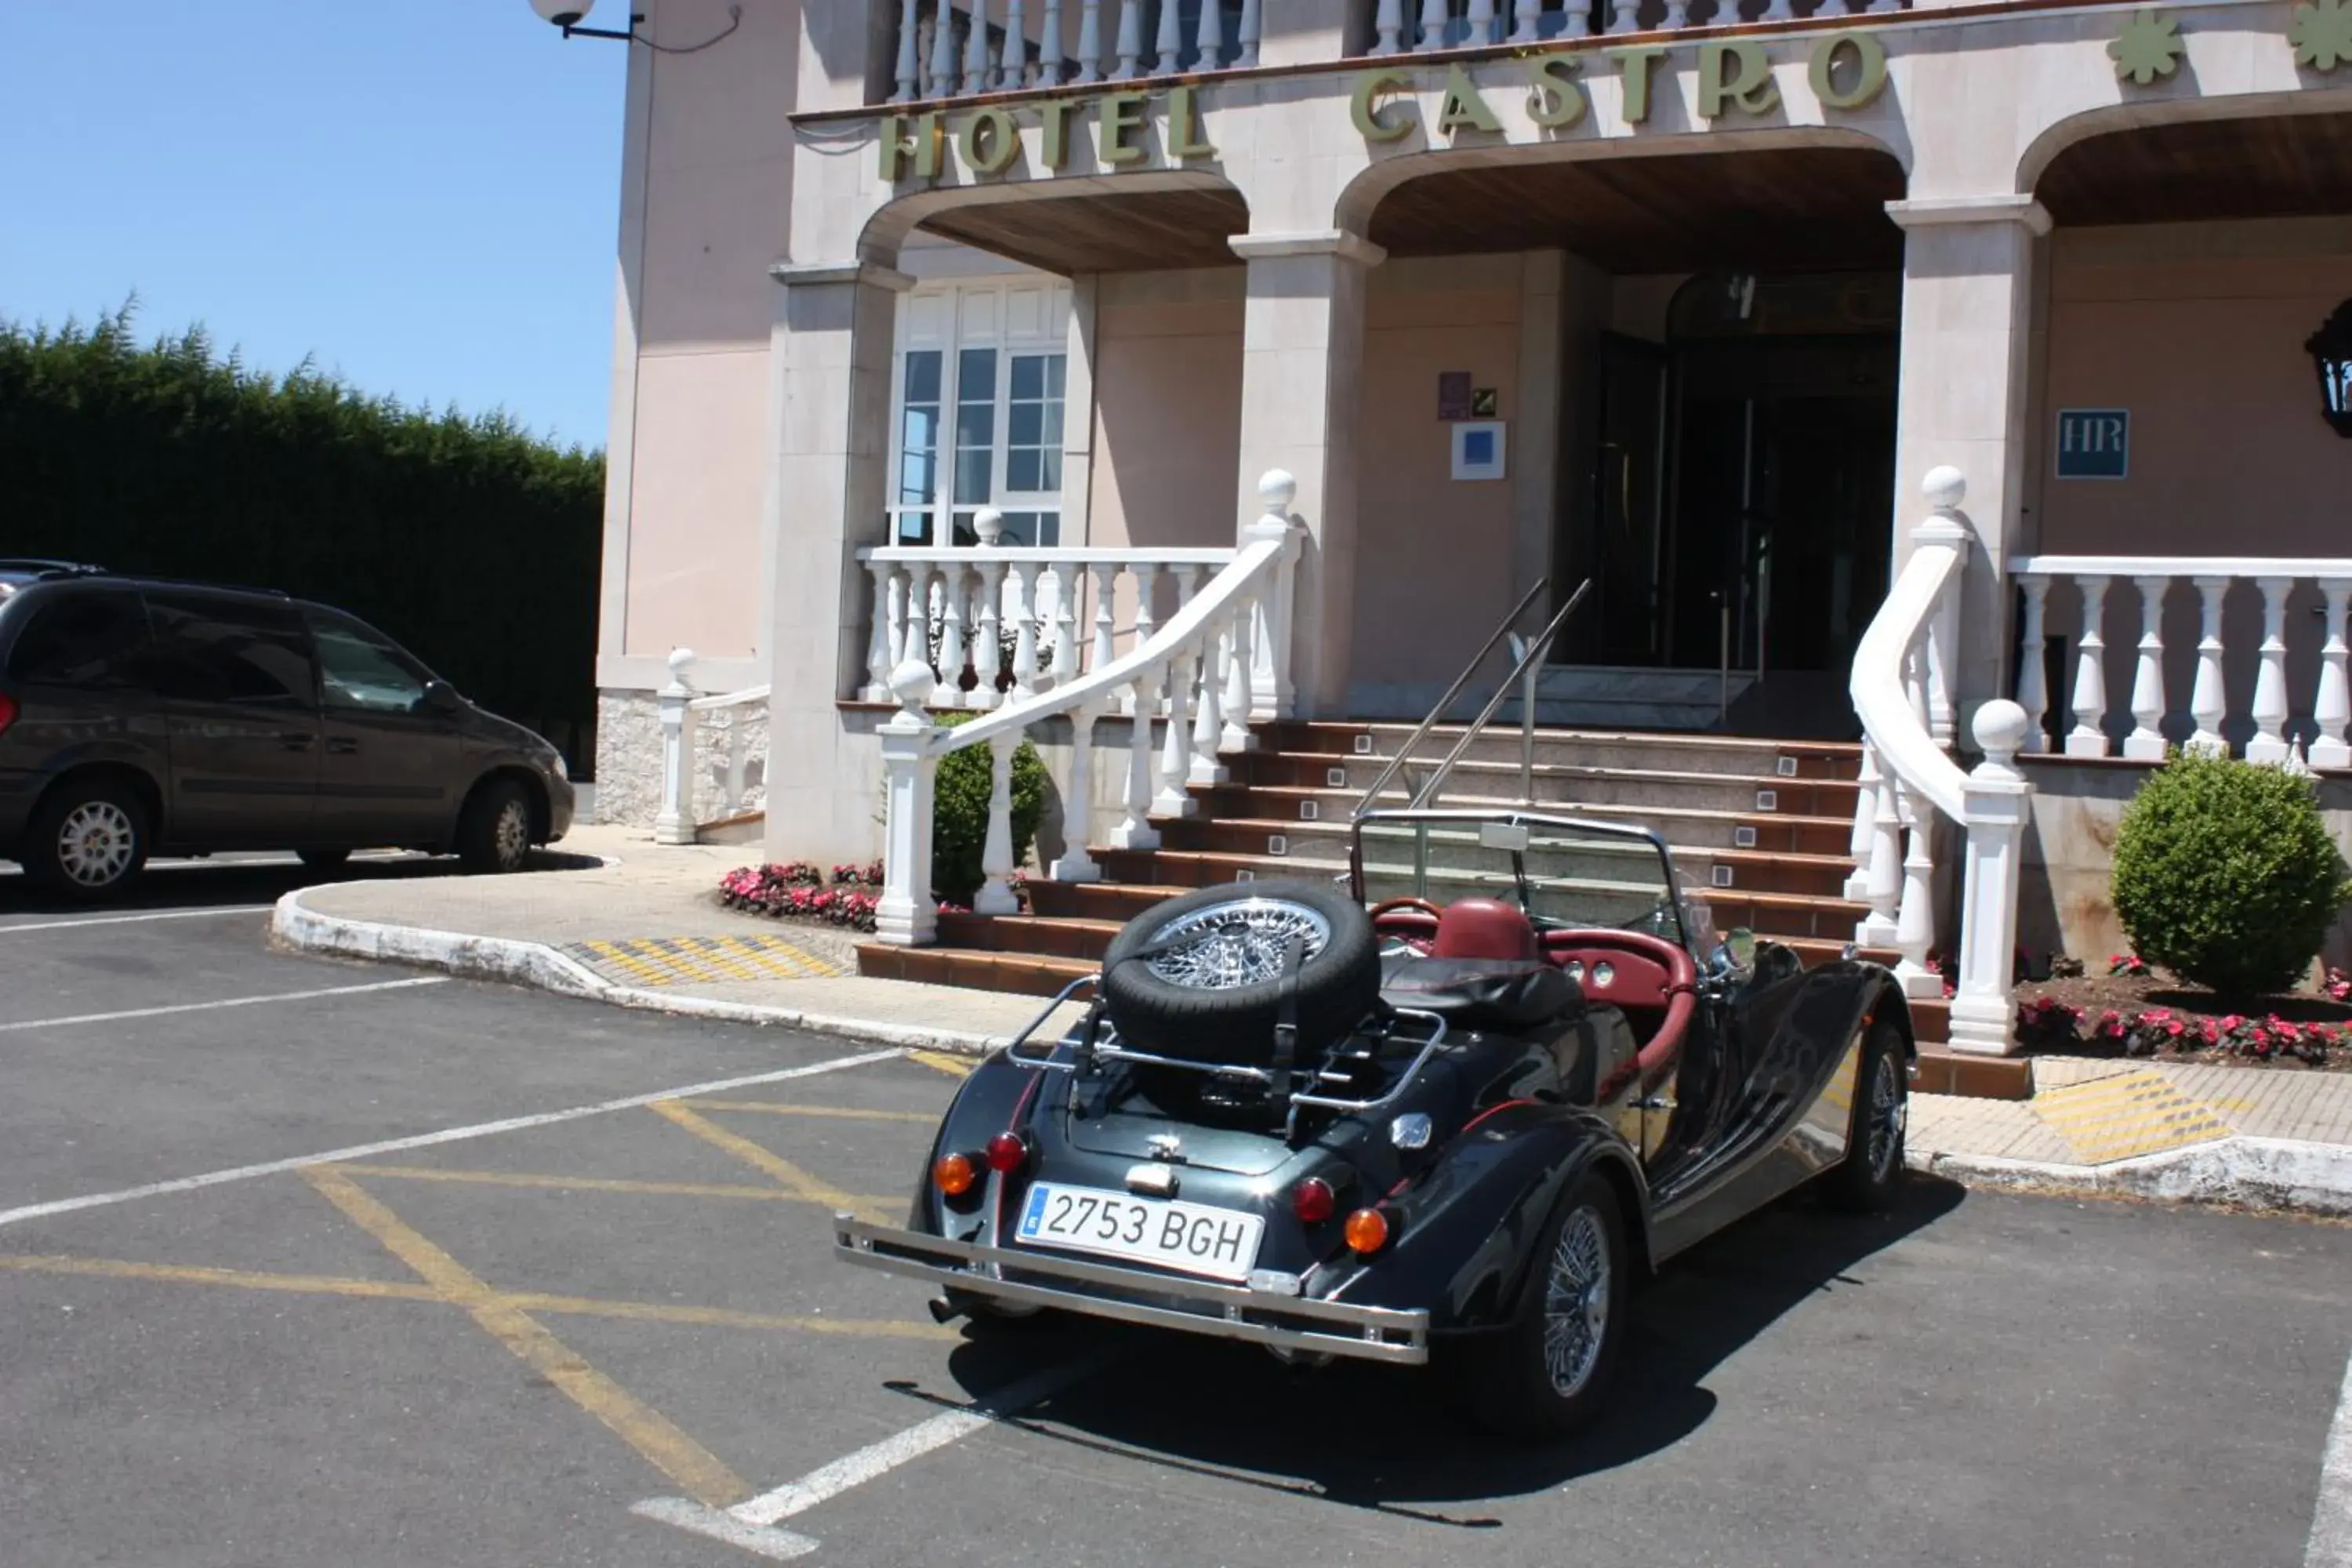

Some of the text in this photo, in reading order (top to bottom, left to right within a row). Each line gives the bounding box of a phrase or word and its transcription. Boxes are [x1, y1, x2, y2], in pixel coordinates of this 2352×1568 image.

[879, 31, 1890, 181] HOTEL CASTRO
[1048, 1195, 1245, 1262] 2753 BGH
